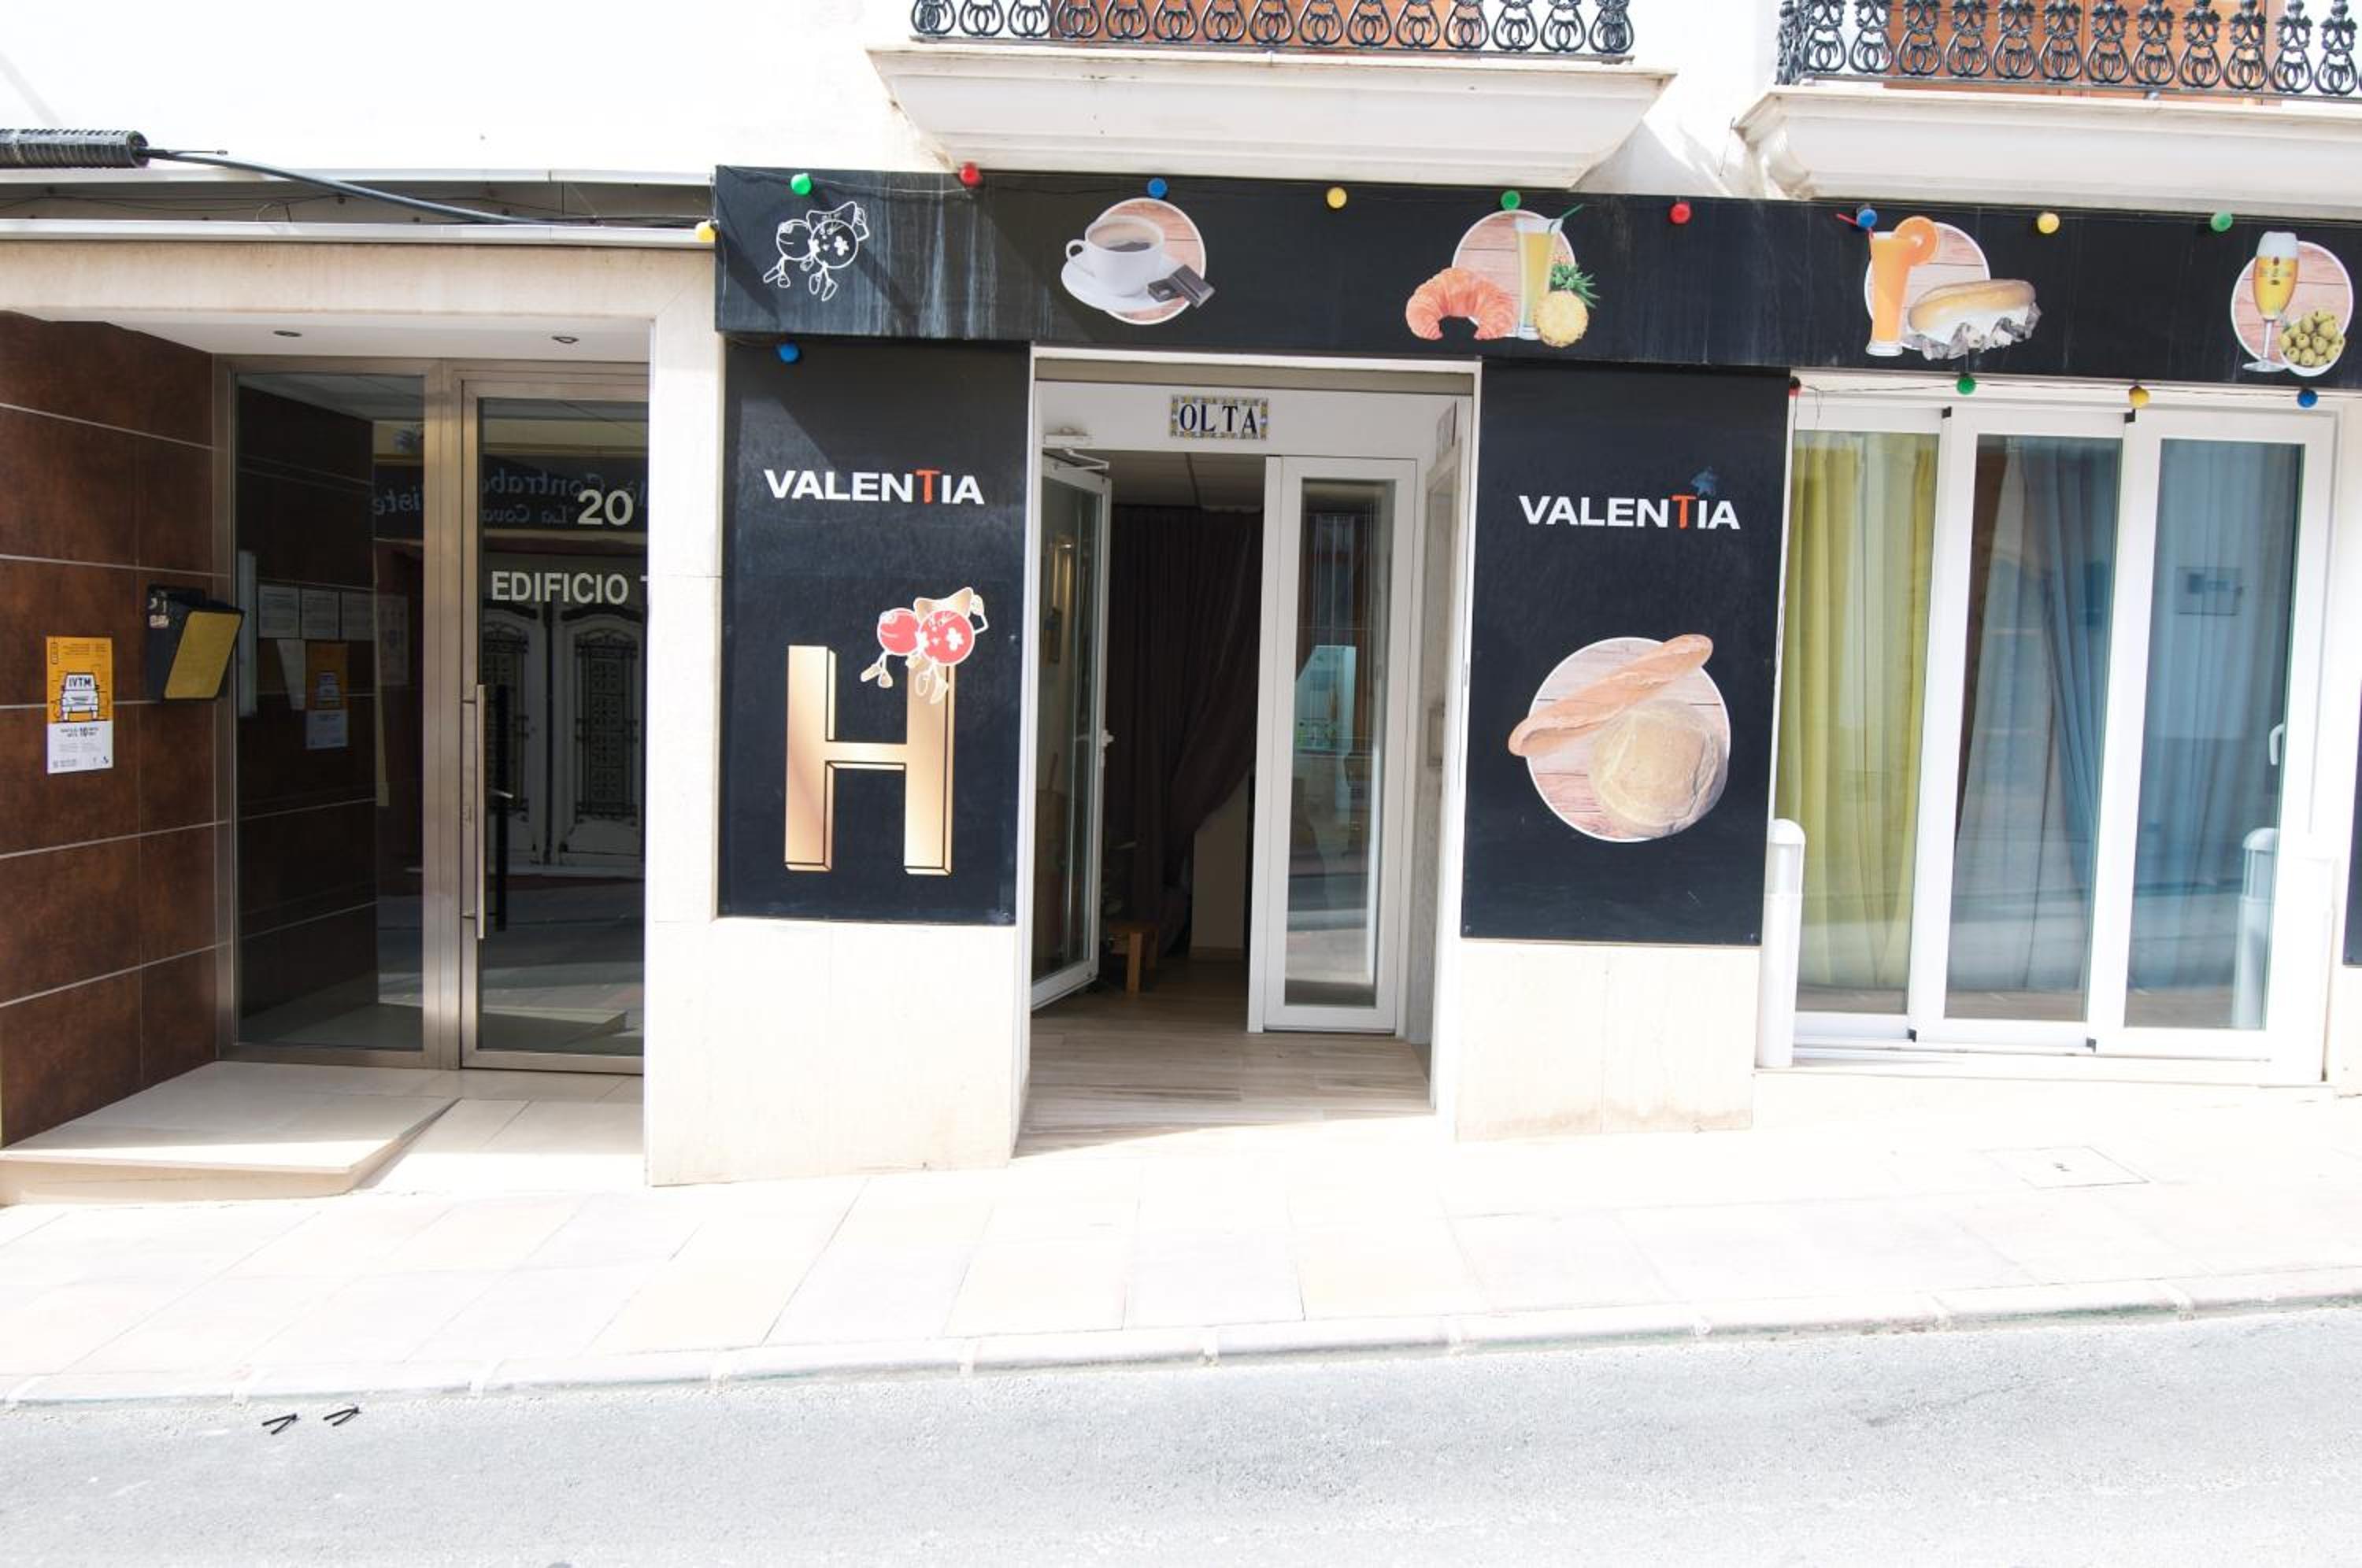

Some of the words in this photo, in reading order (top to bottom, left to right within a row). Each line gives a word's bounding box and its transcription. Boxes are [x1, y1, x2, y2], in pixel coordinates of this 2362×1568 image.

[1179, 404, 1258, 438] OLTA
[764, 468, 985, 505] VALENTIA
[577, 489, 634, 526] 20
[1519, 494, 1741, 531] VALENTIA
[491, 571, 629, 605] EDIFICIO
[68, 677, 92, 687] IVTM
[784, 645, 956, 876] H
